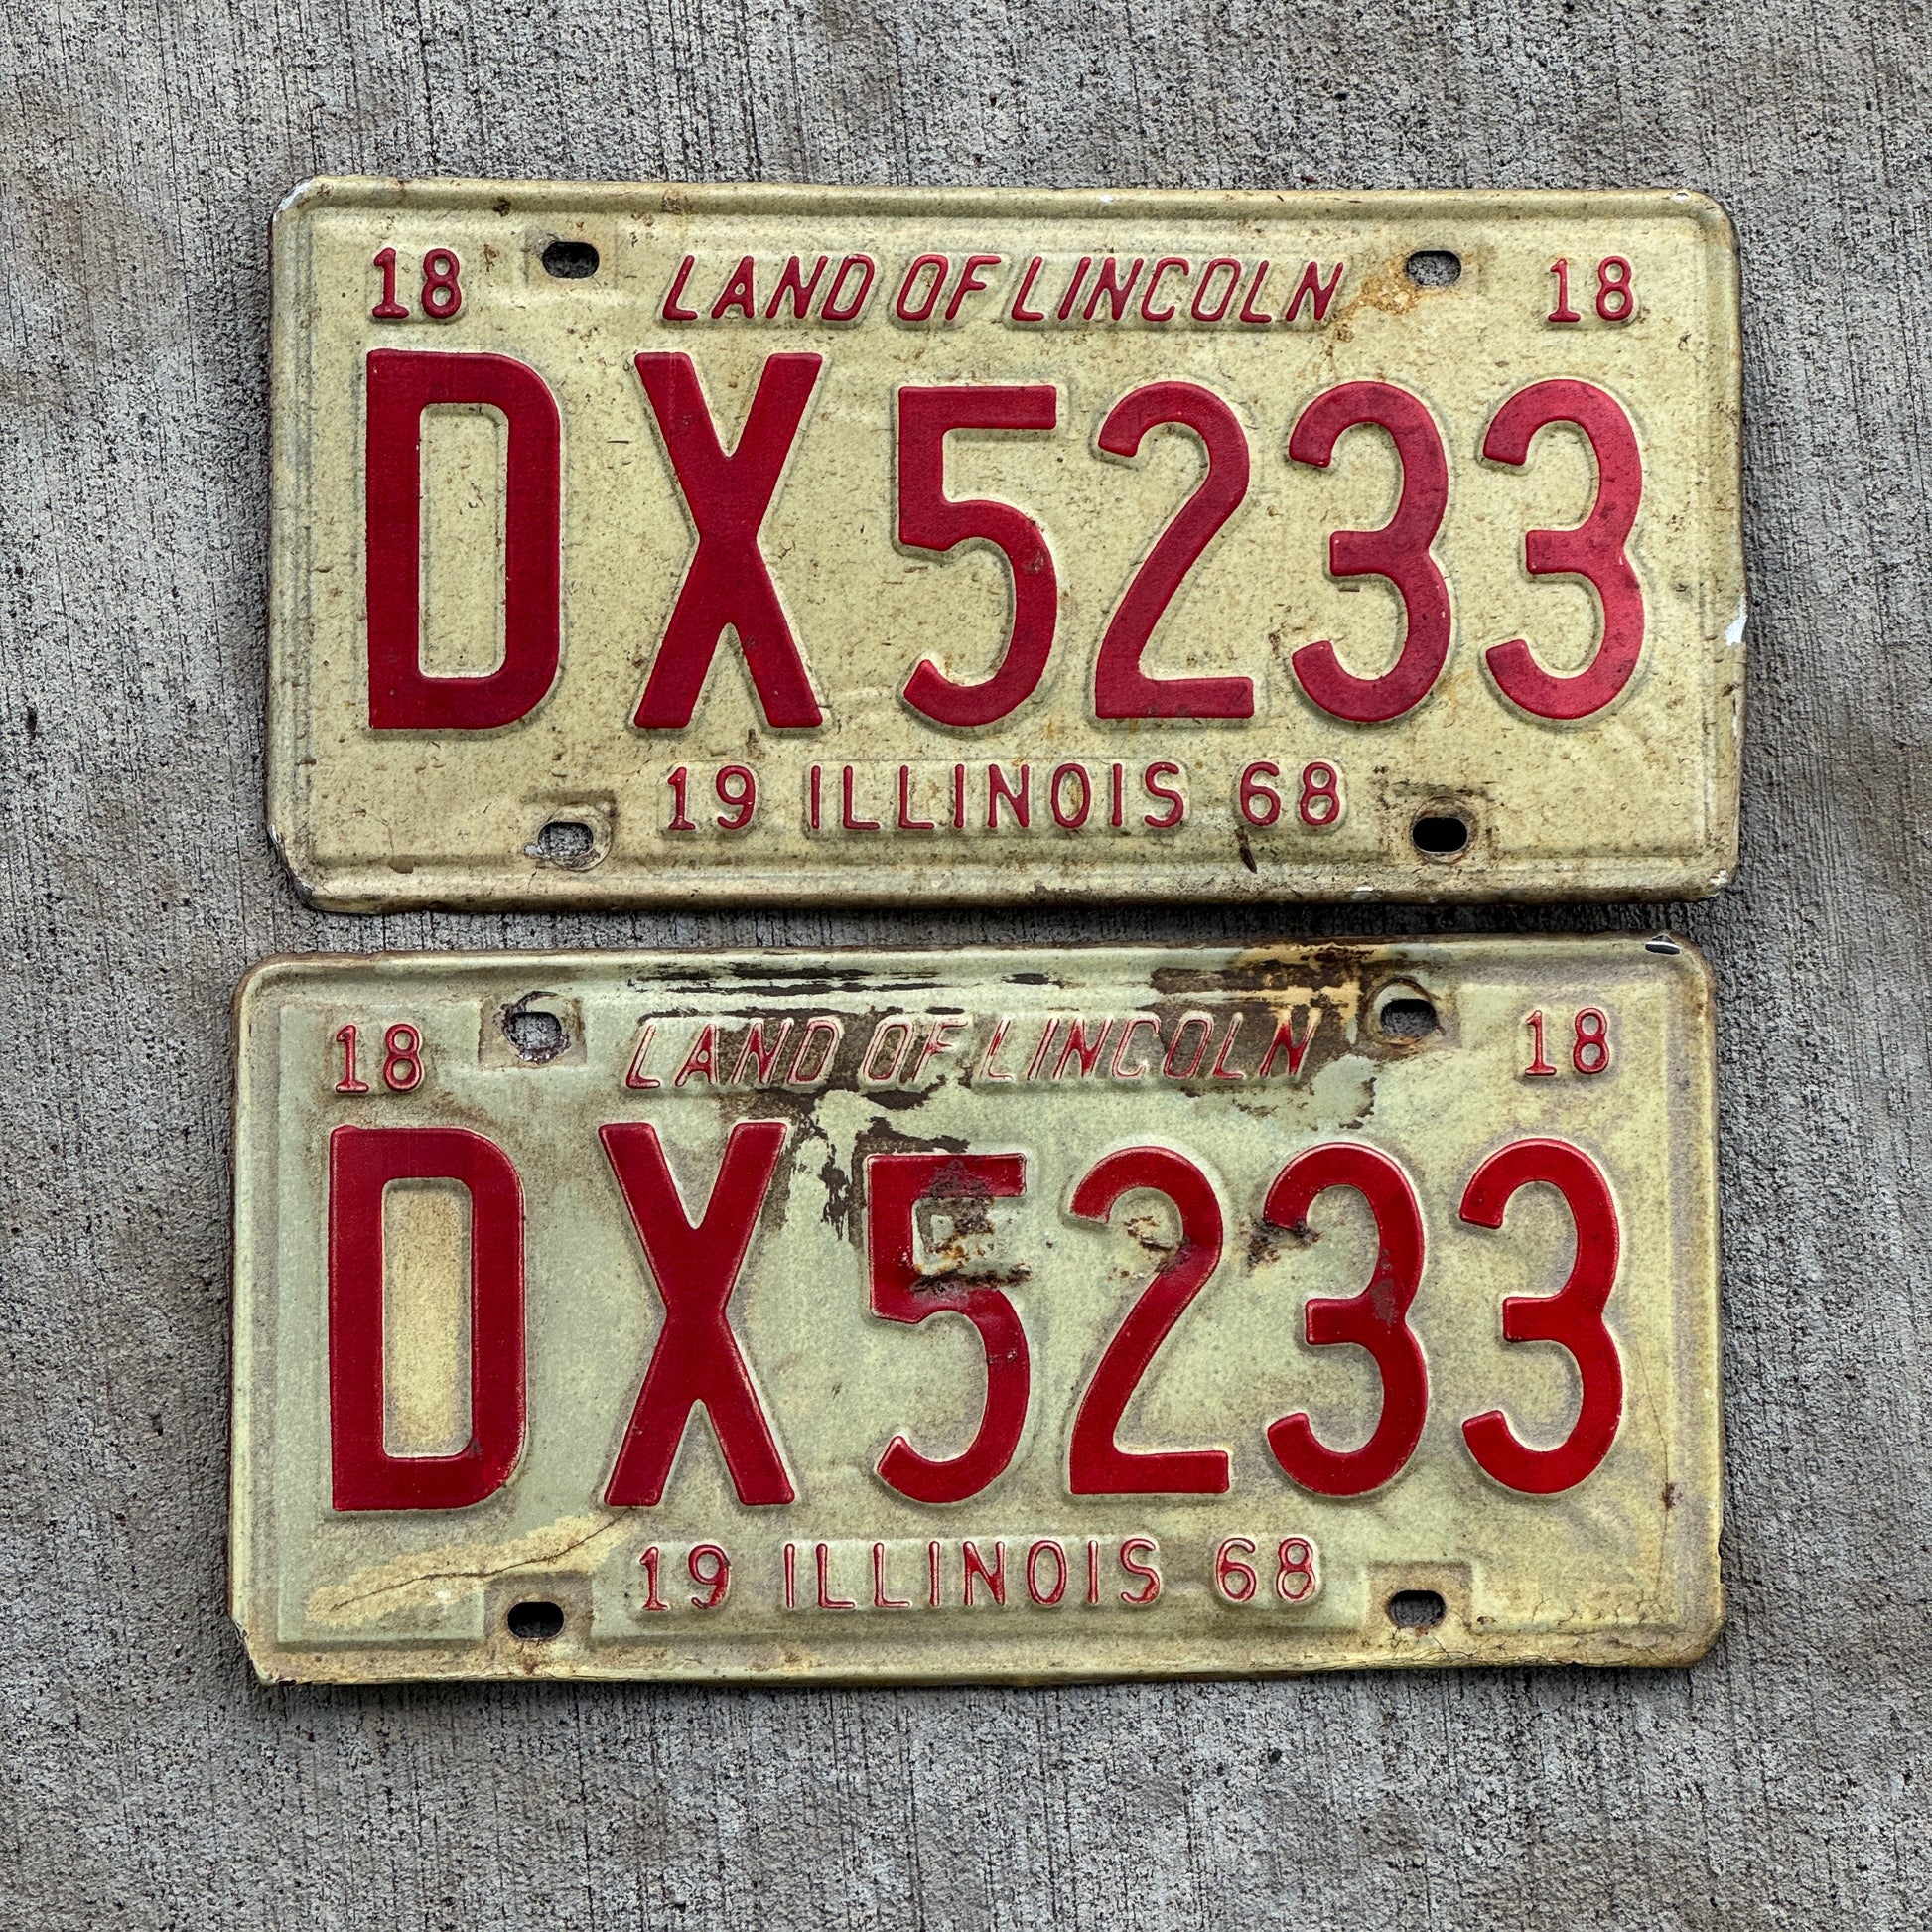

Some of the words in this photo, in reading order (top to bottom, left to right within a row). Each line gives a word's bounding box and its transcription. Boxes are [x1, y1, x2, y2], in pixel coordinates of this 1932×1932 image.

[372, 246, 464, 319] 18
[662, 252, 878, 323] LAND
[896, 252, 1004, 325] OF
[1010, 254, 1346, 326] LINCOLN
[1547, 255, 1635, 324] 18
[667, 763, 758, 832] 19
[809, 761, 1185, 832] ILLINOIS
[1239, 760, 1343, 827] 68
[336, 1022, 425, 1094] 18
[625, 1016, 842, 1089] LAND
[857, 1014, 969, 1086] OF
[977, 1009, 1322, 1083] LINCOLN
[1526, 1006, 1613, 1078] 18
[640, 1543, 733, 1614] 19
[782, 1536, 1163, 1612] ILLINOIS
[1213, 1535, 1321, 1604] 68
